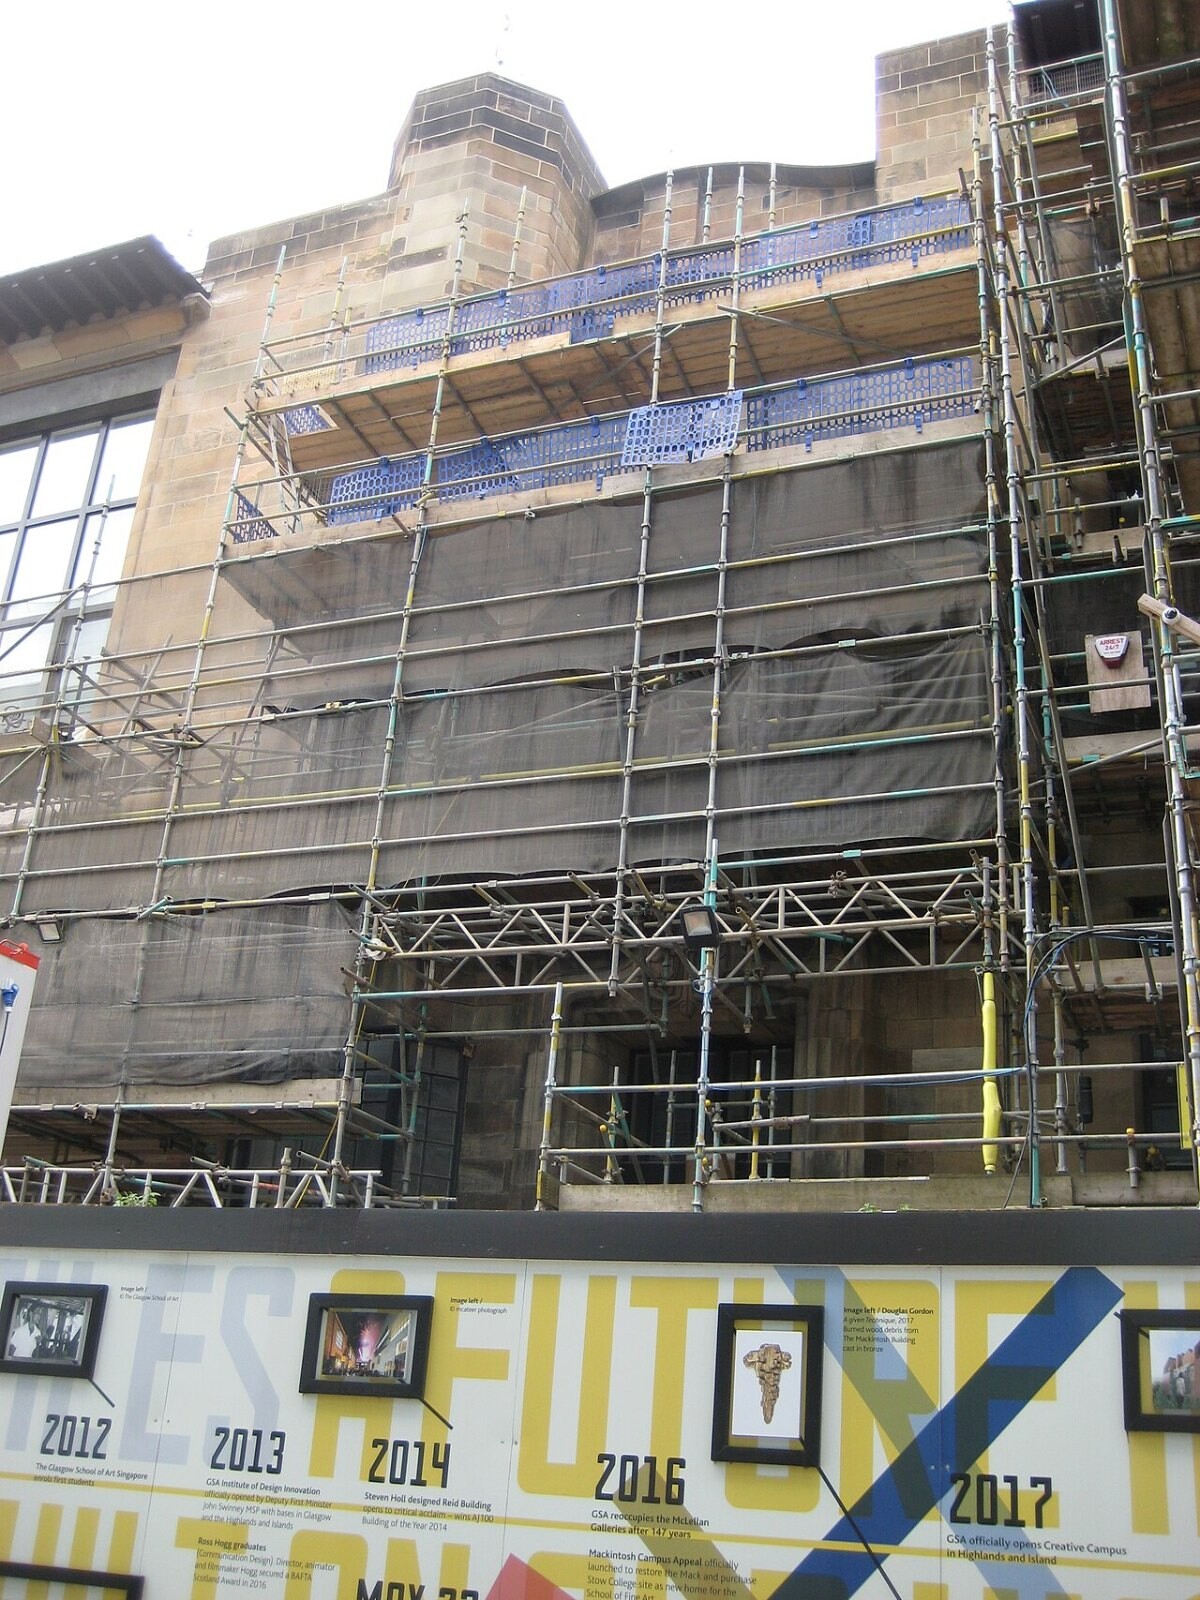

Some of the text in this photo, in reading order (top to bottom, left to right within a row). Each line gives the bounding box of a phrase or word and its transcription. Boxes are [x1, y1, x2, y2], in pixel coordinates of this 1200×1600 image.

[844, 1307, 862, 1315] Image
[882, 1307, 908, 1315] Douglas
[40, 1414, 112, 1460] 2012
[211, 1427, 286, 1474] 2013
[48, 1464, 74, 1474] Glasgow
[76, 1466, 96, 1475] School
[105, 1469, 115, 1477] Art
[117, 1470, 148, 1481] Singapore
[368, 1439, 451, 1488] 2014
[34, 1474, 95, 1487] enrols first students
[206, 1478, 320, 1495] GSA Institute of Design Innovation
[595, 1453, 686, 1505] 2016
[205, 1490, 333, 1509] officially opened by Deputy First Minister
[365, 1492, 491, 1512] Steven Holl designed Reid Building
[950, 1473, 1052, 1529] 2017
[203, 1502, 217, 1511] John
[246, 1505, 260, 1514] MSP
[261, 1506, 276, 1515] with
[277, 1508, 294, 1518] bases
[296, 1510, 302, 1518] in
[304, 1511, 331, 1522] Glasgow
[363, 1505, 384, 1514] opens
[385, 1506, 392, 1514] to
[394, 1506, 417, 1516] critical
[420, 1510, 446, 1519] acclaim
[454, 1513, 471, 1521] wins
[592, 1510, 709, 1527] GSA reoccupies the McLellan
[214, 1514, 225, 1522] the
[226, 1516, 257, 1527] Highlands
[258, 1518, 270, 1527] and
[272, 1520, 293, 1530] Islands
[362, 1516, 447, 1531] Building of the Year 2014
[591, 1523, 691, 1539] Galleries after 147 years
[198, 1537, 266, 1552] Ross Hogg graduates
[947, 1535, 1127, 1556] GSA officially opens Creative Campus
[197, 1548, 248, 1562] (Communication
[276, 1558, 303, 1569] Director,
[305, 1560, 335, 1570] animator
[589, 1549, 739, 1571] Mackintosh Campus Appeal officially
[947, 1548, 1057, 1565] in Highlands and Island
[195, 1561, 206, 1570] and
[208, 1562, 239, 1573] filmmaker
[240, 1566, 258, 1577] Hogg
[259, 1568, 284, 1578] secured
[291, 1572, 312, 1581] BAFTA
[588, 1562, 757, 1586] launched to restore the Mack and purchase
[193, 1574, 219, 1584] Scotland
[221, 1577, 241, 1586] Award
[250, 1579, 266, 1589] 2016
[587, 1575, 606, 1585] Stow
[608, 1577, 636, 1590] College
[638, 1580, 652, 1589] site
[684, 1584, 706, 1594] home
[709, 1586, 721, 1595] for
[723, 1587, 737, 1597] the
[587, 1588, 612, 1599] School
[614, 1591, 623, 1600] of
[625, 1591, 639, 1600] Fine
